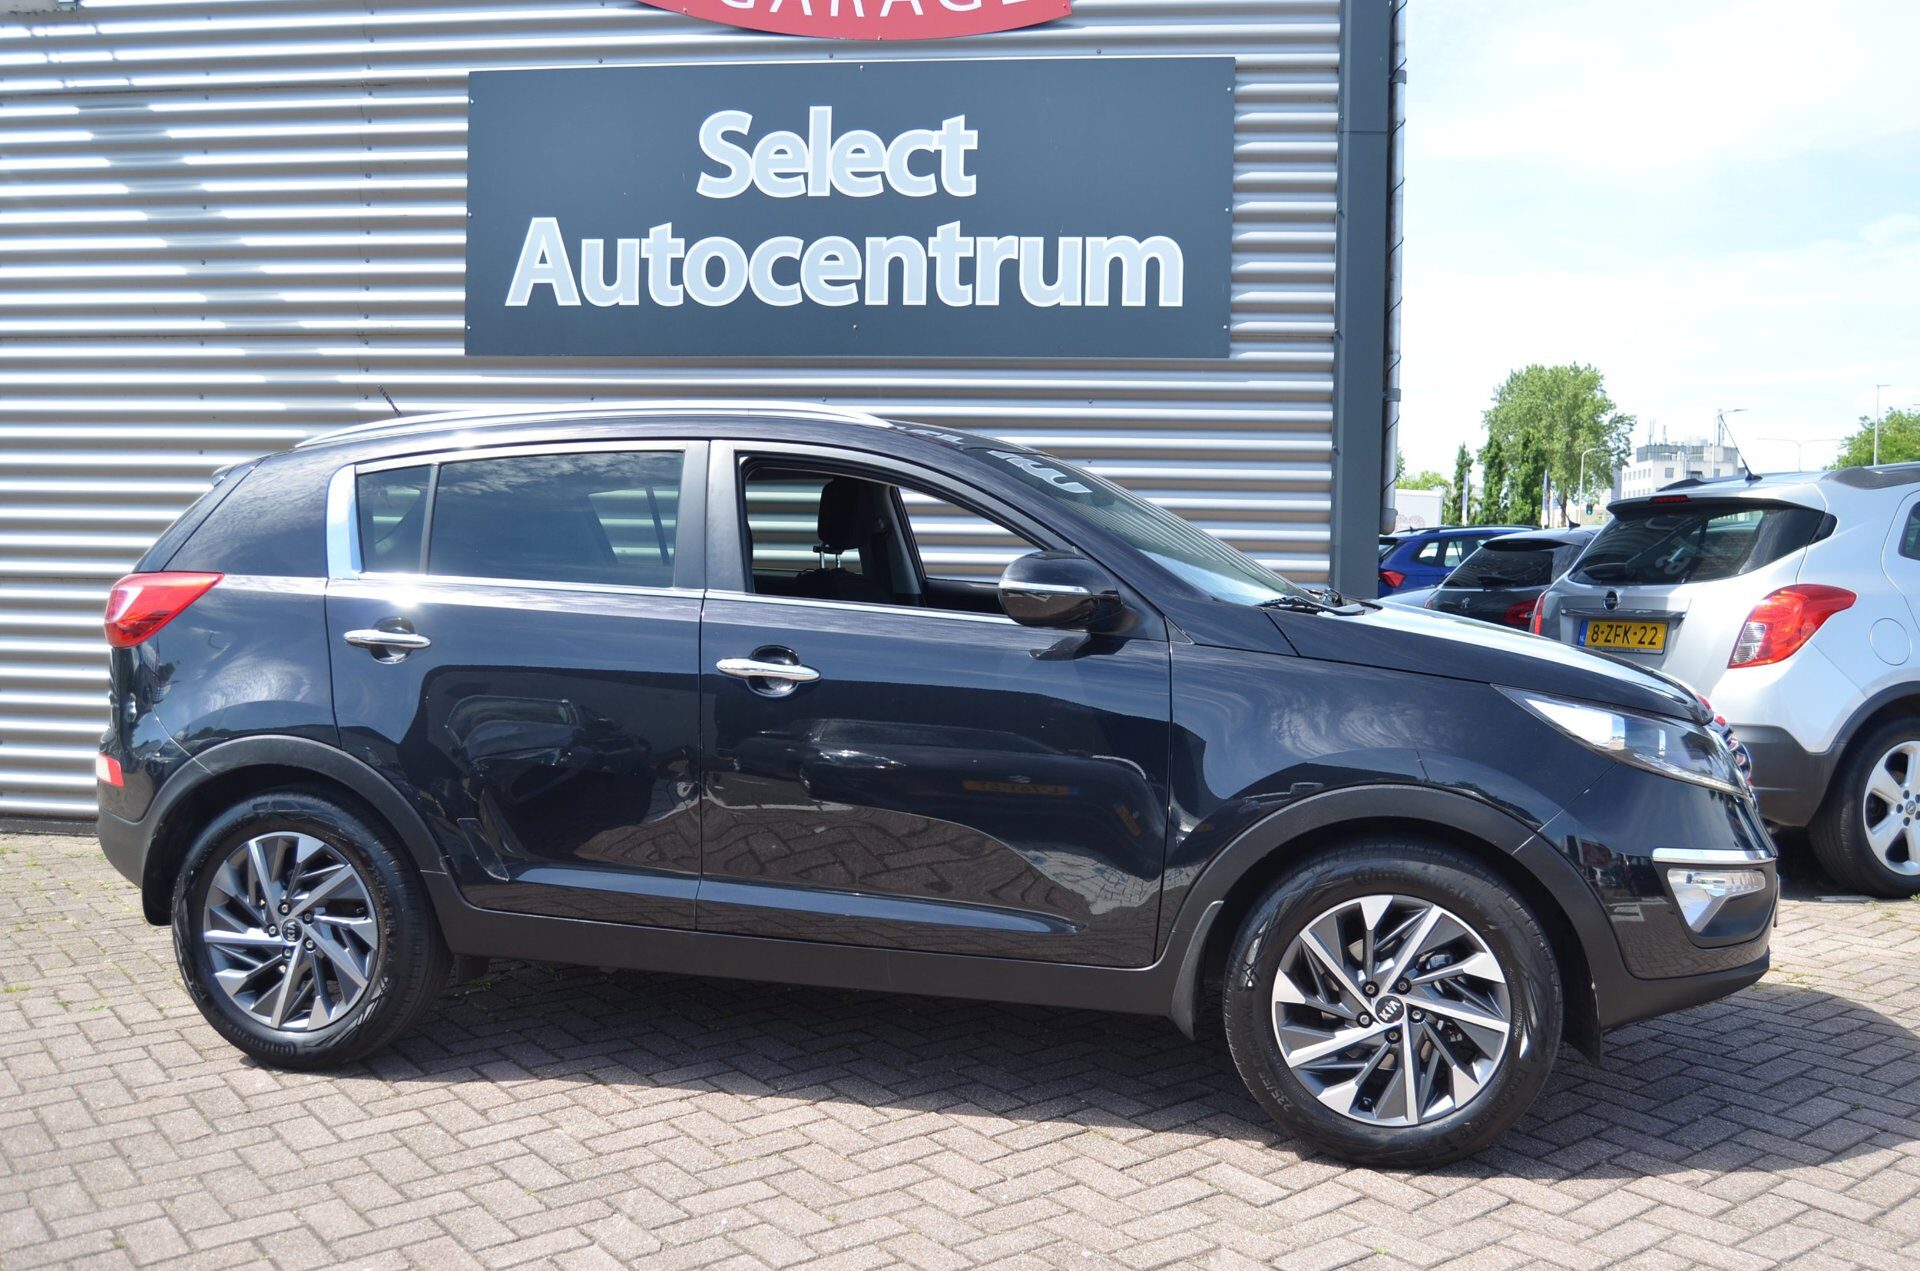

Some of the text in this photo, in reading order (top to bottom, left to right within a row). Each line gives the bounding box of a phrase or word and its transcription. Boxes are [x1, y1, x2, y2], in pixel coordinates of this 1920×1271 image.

[696, 105, 978, 198] Select
[504, 216, 1184, 308] Autocentrum
[1590, 624, 1658, 645] 8-ZFK-22
[1379, 1000, 1400, 1020] KIA
